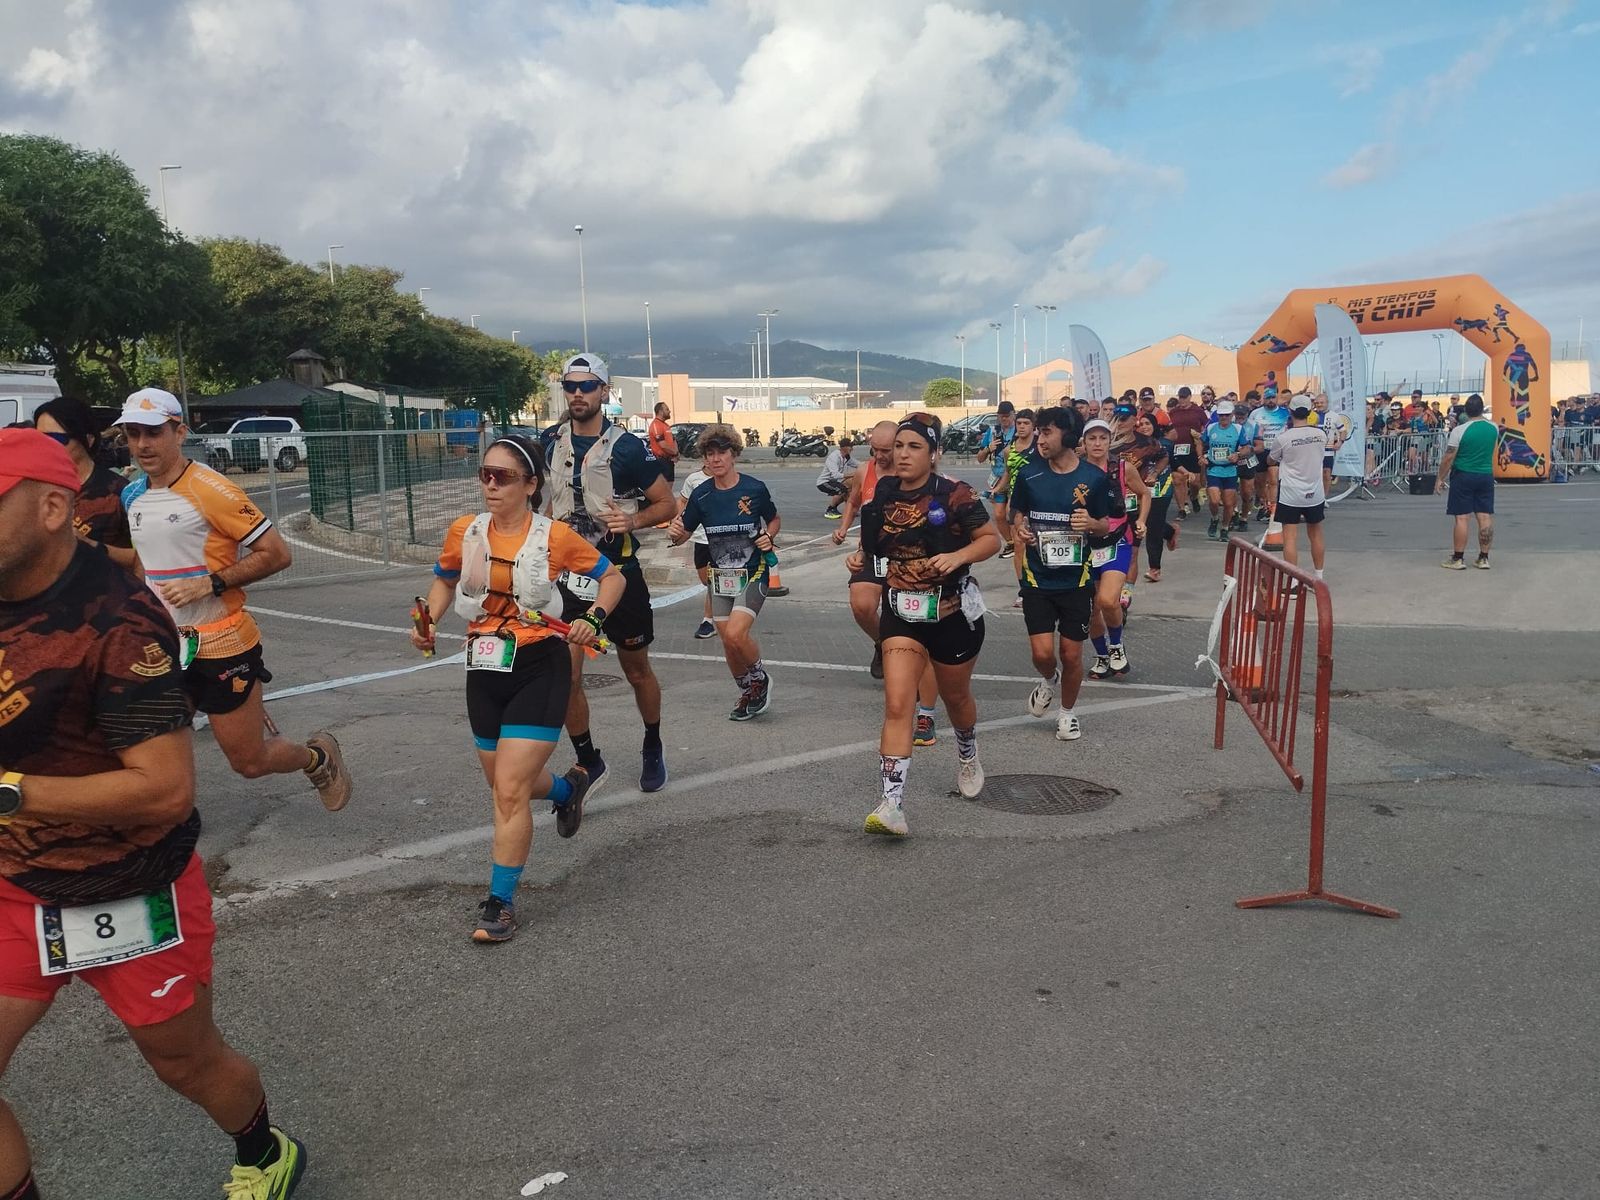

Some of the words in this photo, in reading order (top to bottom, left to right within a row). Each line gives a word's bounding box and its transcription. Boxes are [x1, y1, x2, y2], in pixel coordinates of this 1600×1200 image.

[1347, 297, 1373, 308] MIS
[1376, 289, 1437, 305] TIEMPOS
[1371, 299, 1436, 322] CHIP
[1050, 547, 1070, 557] 205
[575, 576, 591, 589] 17
[723, 579, 735, 588] 61
[904, 598, 920, 611] 39
[477, 641, 495, 656] 59
[94, 912, 116, 939] 8
[65, 957, 108, 969] HONOR
